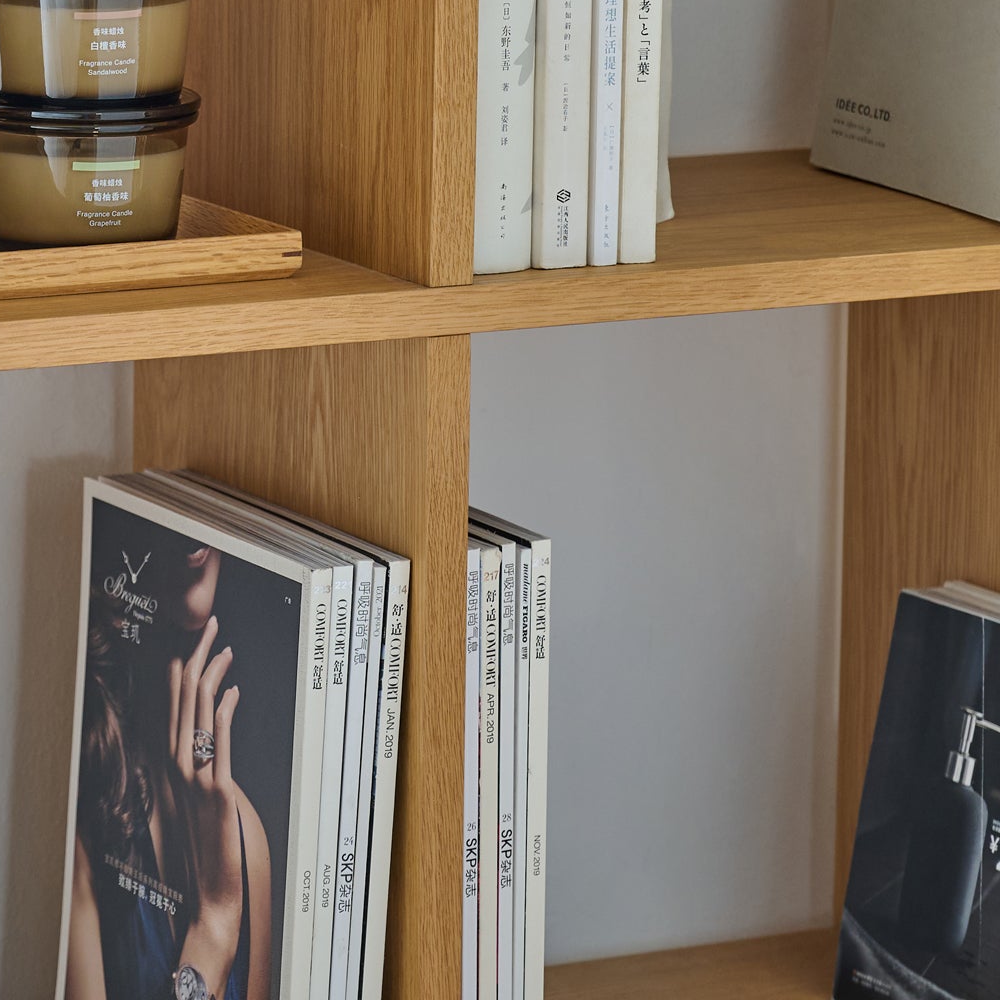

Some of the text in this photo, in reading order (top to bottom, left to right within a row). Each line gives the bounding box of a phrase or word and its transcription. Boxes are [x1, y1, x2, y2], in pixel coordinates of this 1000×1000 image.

[90, 40, 127, 51] 白檀香味
[76, 209, 133, 218] Fragrance Candle
[84, 191, 129, 202] 葡萄柚香味
[103, 573, 158, 614] Breguet
[373, 585, 384, 638] October 2021
[467, 570, 479, 654] 呼吸时尚气息
[502, 563, 515, 647] 呼吸时尚气息
[535, 574, 547, 633] COMFORT
[313, 603, 326, 662] COMFORT
[333, 599, 347, 657] COMFORT
[354, 581, 371, 665] 呼吸时尚气息
[386, 638, 403, 703] COMFORT
[485, 623, 497, 688] COMFORT
[384, 707, 395, 759] JAN.2019
[486, 692, 495, 744] APR.2019
[466, 822, 476, 832] 26
[502, 813, 512, 823] 28
[465, 837, 477, 898] SKP杂志
[501, 829, 513, 889] SKP杂志
[533, 835, 541, 877] NOV.2019
[302, 870, 311, 913] OCT.2019
[321, 864, 331, 908] AUG.2019
[338, 853, 355, 914] SKP杂志
